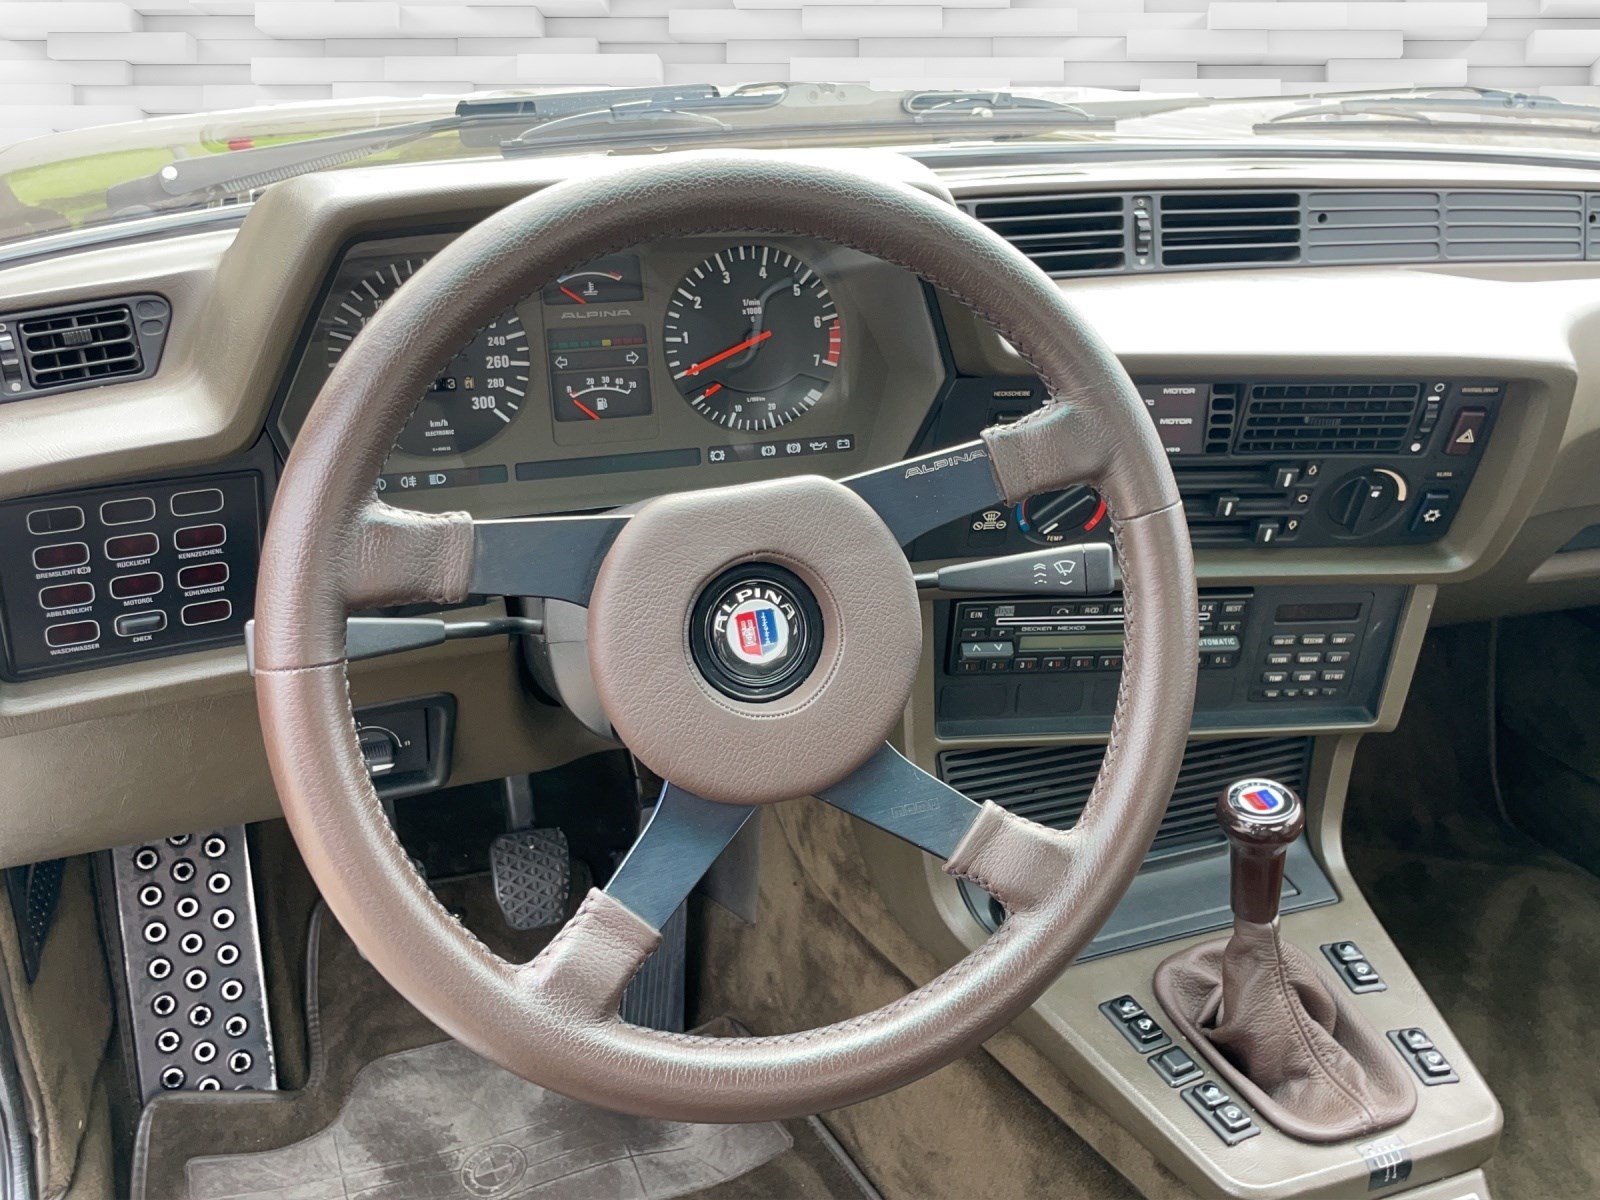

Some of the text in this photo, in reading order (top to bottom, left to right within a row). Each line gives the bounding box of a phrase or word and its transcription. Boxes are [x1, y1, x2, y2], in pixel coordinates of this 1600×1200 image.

[723, 271, 731, 284] 3
[759, 266, 768, 279] 4
[793, 284, 801, 297] 5
[694, 296, 702, 309] 2
[561, 309, 632, 319] ALPINA
[814, 316, 821, 328] 6
[487, 336, 506, 347] 240
[682, 331, 689, 344] 1
[486, 355, 510, 369] 260
[813, 354, 821, 366] 7
[487, 378, 505, 389] 280
[586, 377, 595, 385] 20
[601, 376, 610, 384] 30
[1163, 387, 1196, 395] MOTOR
[471, 396, 496, 410] 300
[430, 419, 448, 428] km/h
[1159, 417, 1193, 425] MOTOR
[425, 429, 455, 437] ELECTRONIC
[905, 449, 987, 479] ALPINA
[116, 558, 151, 569] RÜCKLICHT
[35, 568, 77, 580] BREMSLICHT
[184, 585, 225, 597] KÜHLWASSER
[46, 606, 93, 618] ABBLENDLICHT
[713, 587, 797, 633] ALPINA
[1225, 604, 1243, 612] BEST
[970, 611, 983, 619] EIN
[132, 634, 153, 644] CHECK
[1198, 637, 1236, 646] UTOMATIC
[50, 643, 100, 656] WASCHWASSER
